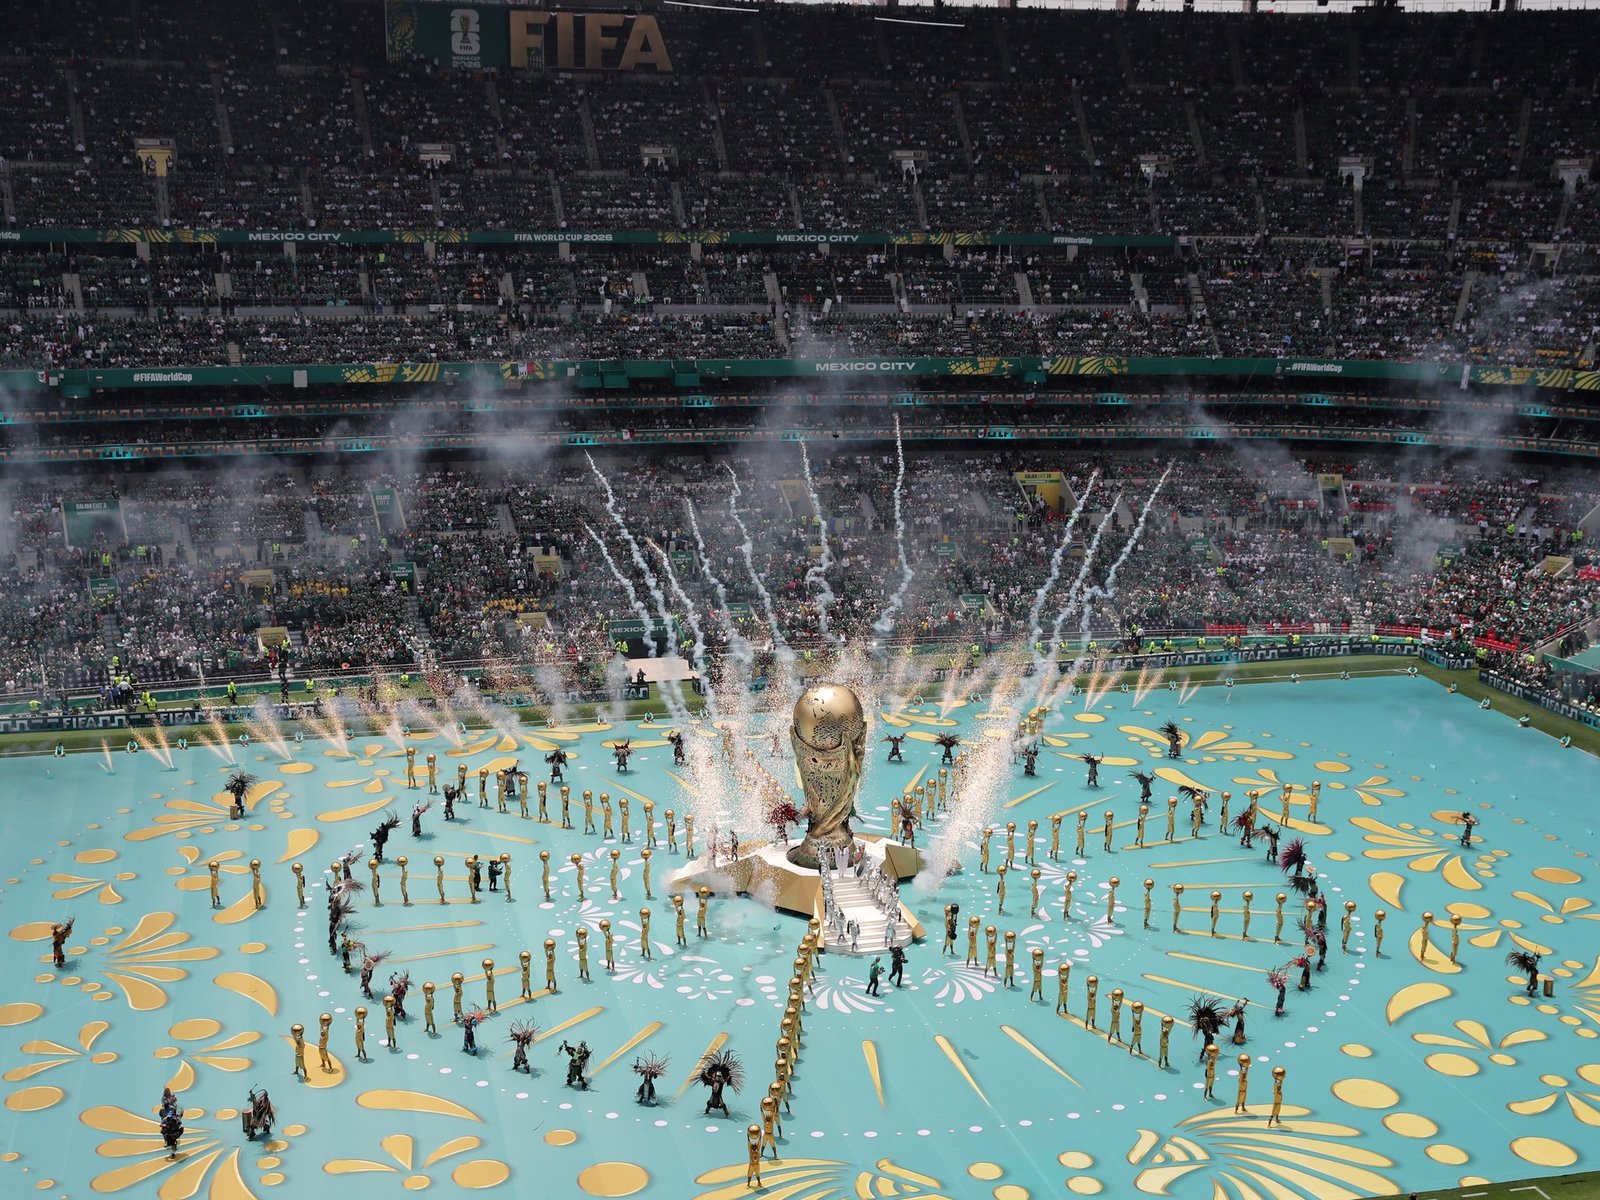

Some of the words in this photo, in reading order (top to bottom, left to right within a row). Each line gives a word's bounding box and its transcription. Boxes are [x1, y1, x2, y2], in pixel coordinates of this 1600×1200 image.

[509, 9, 674, 73] FIFA
[248, 233, 304, 241] MEXICO
[307, 233, 341, 241] CITY
[514, 233, 531, 241] FIFA
[533, 233, 562, 241] WORLD
[564, 233, 582, 241] CUP
[583, 233, 613, 241] 2026
[776, 234, 828, 242] MEXICO
[829, 234, 859, 242] CITY
[1053, 236, 1093, 245] #FIFAWorldCup
[815, 362, 877, 371] MEXICO
[879, 362, 916, 371] CITY
[1291, 363, 1343, 373] #FIFAWorldCup
[133, 372, 192, 383] #FIFAWorldCup
[609, 625, 647, 633] MEXICO
[1302, 645, 1327, 657] FIFA
[1374, 644, 1402, 655] FIFA
[1159, 654, 1183, 667] FIFA
[1230, 652, 1256, 663] FIFA
[1488, 676, 1507, 690] FIFA
[1541, 696, 1561, 713] FIFA
[160, 711, 194, 724] FIFA
[62, 717, 100, 731] FIFA
